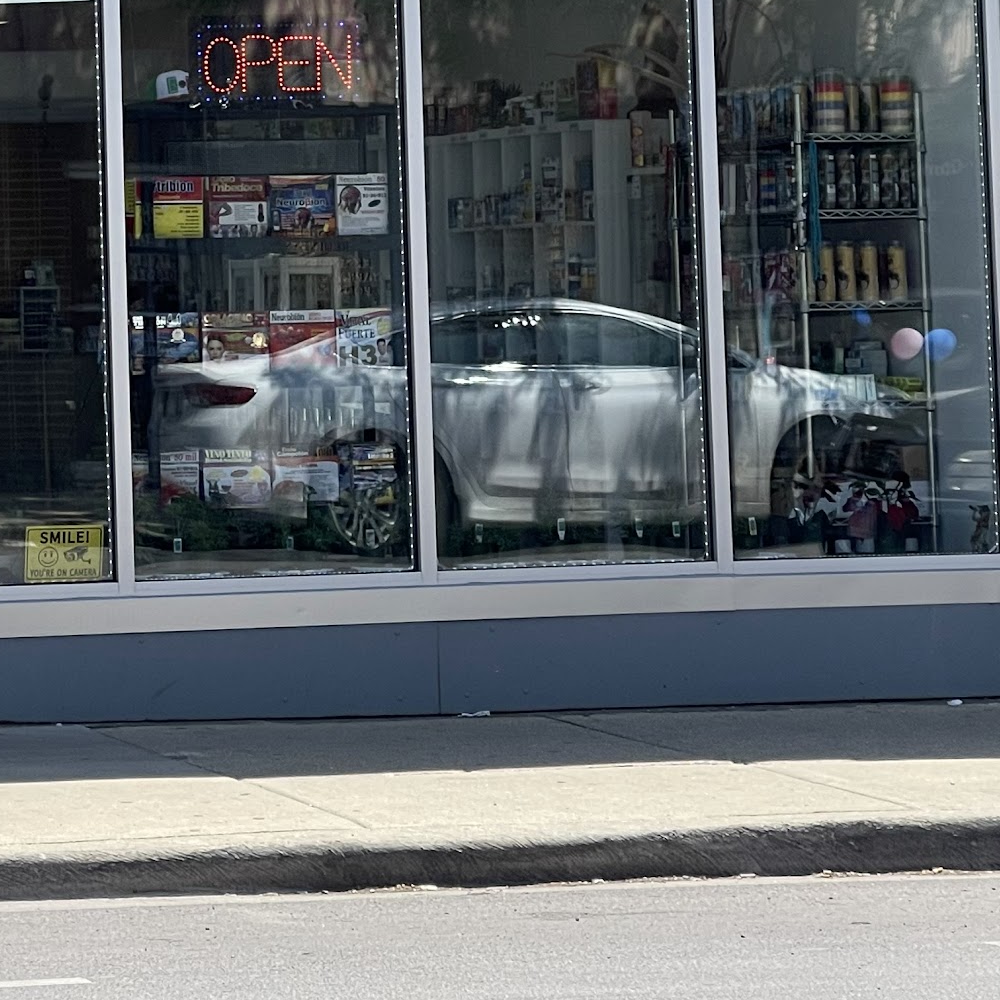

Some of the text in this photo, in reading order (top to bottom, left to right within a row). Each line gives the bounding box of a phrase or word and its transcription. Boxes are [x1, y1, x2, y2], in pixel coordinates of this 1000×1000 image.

[203, 33, 353, 93] OPEN
[153, 180, 195, 193] tribion
[40, 530, 90, 544] SMILE!
[30, 567, 97, 578] YOU'RE ON CAMERA
